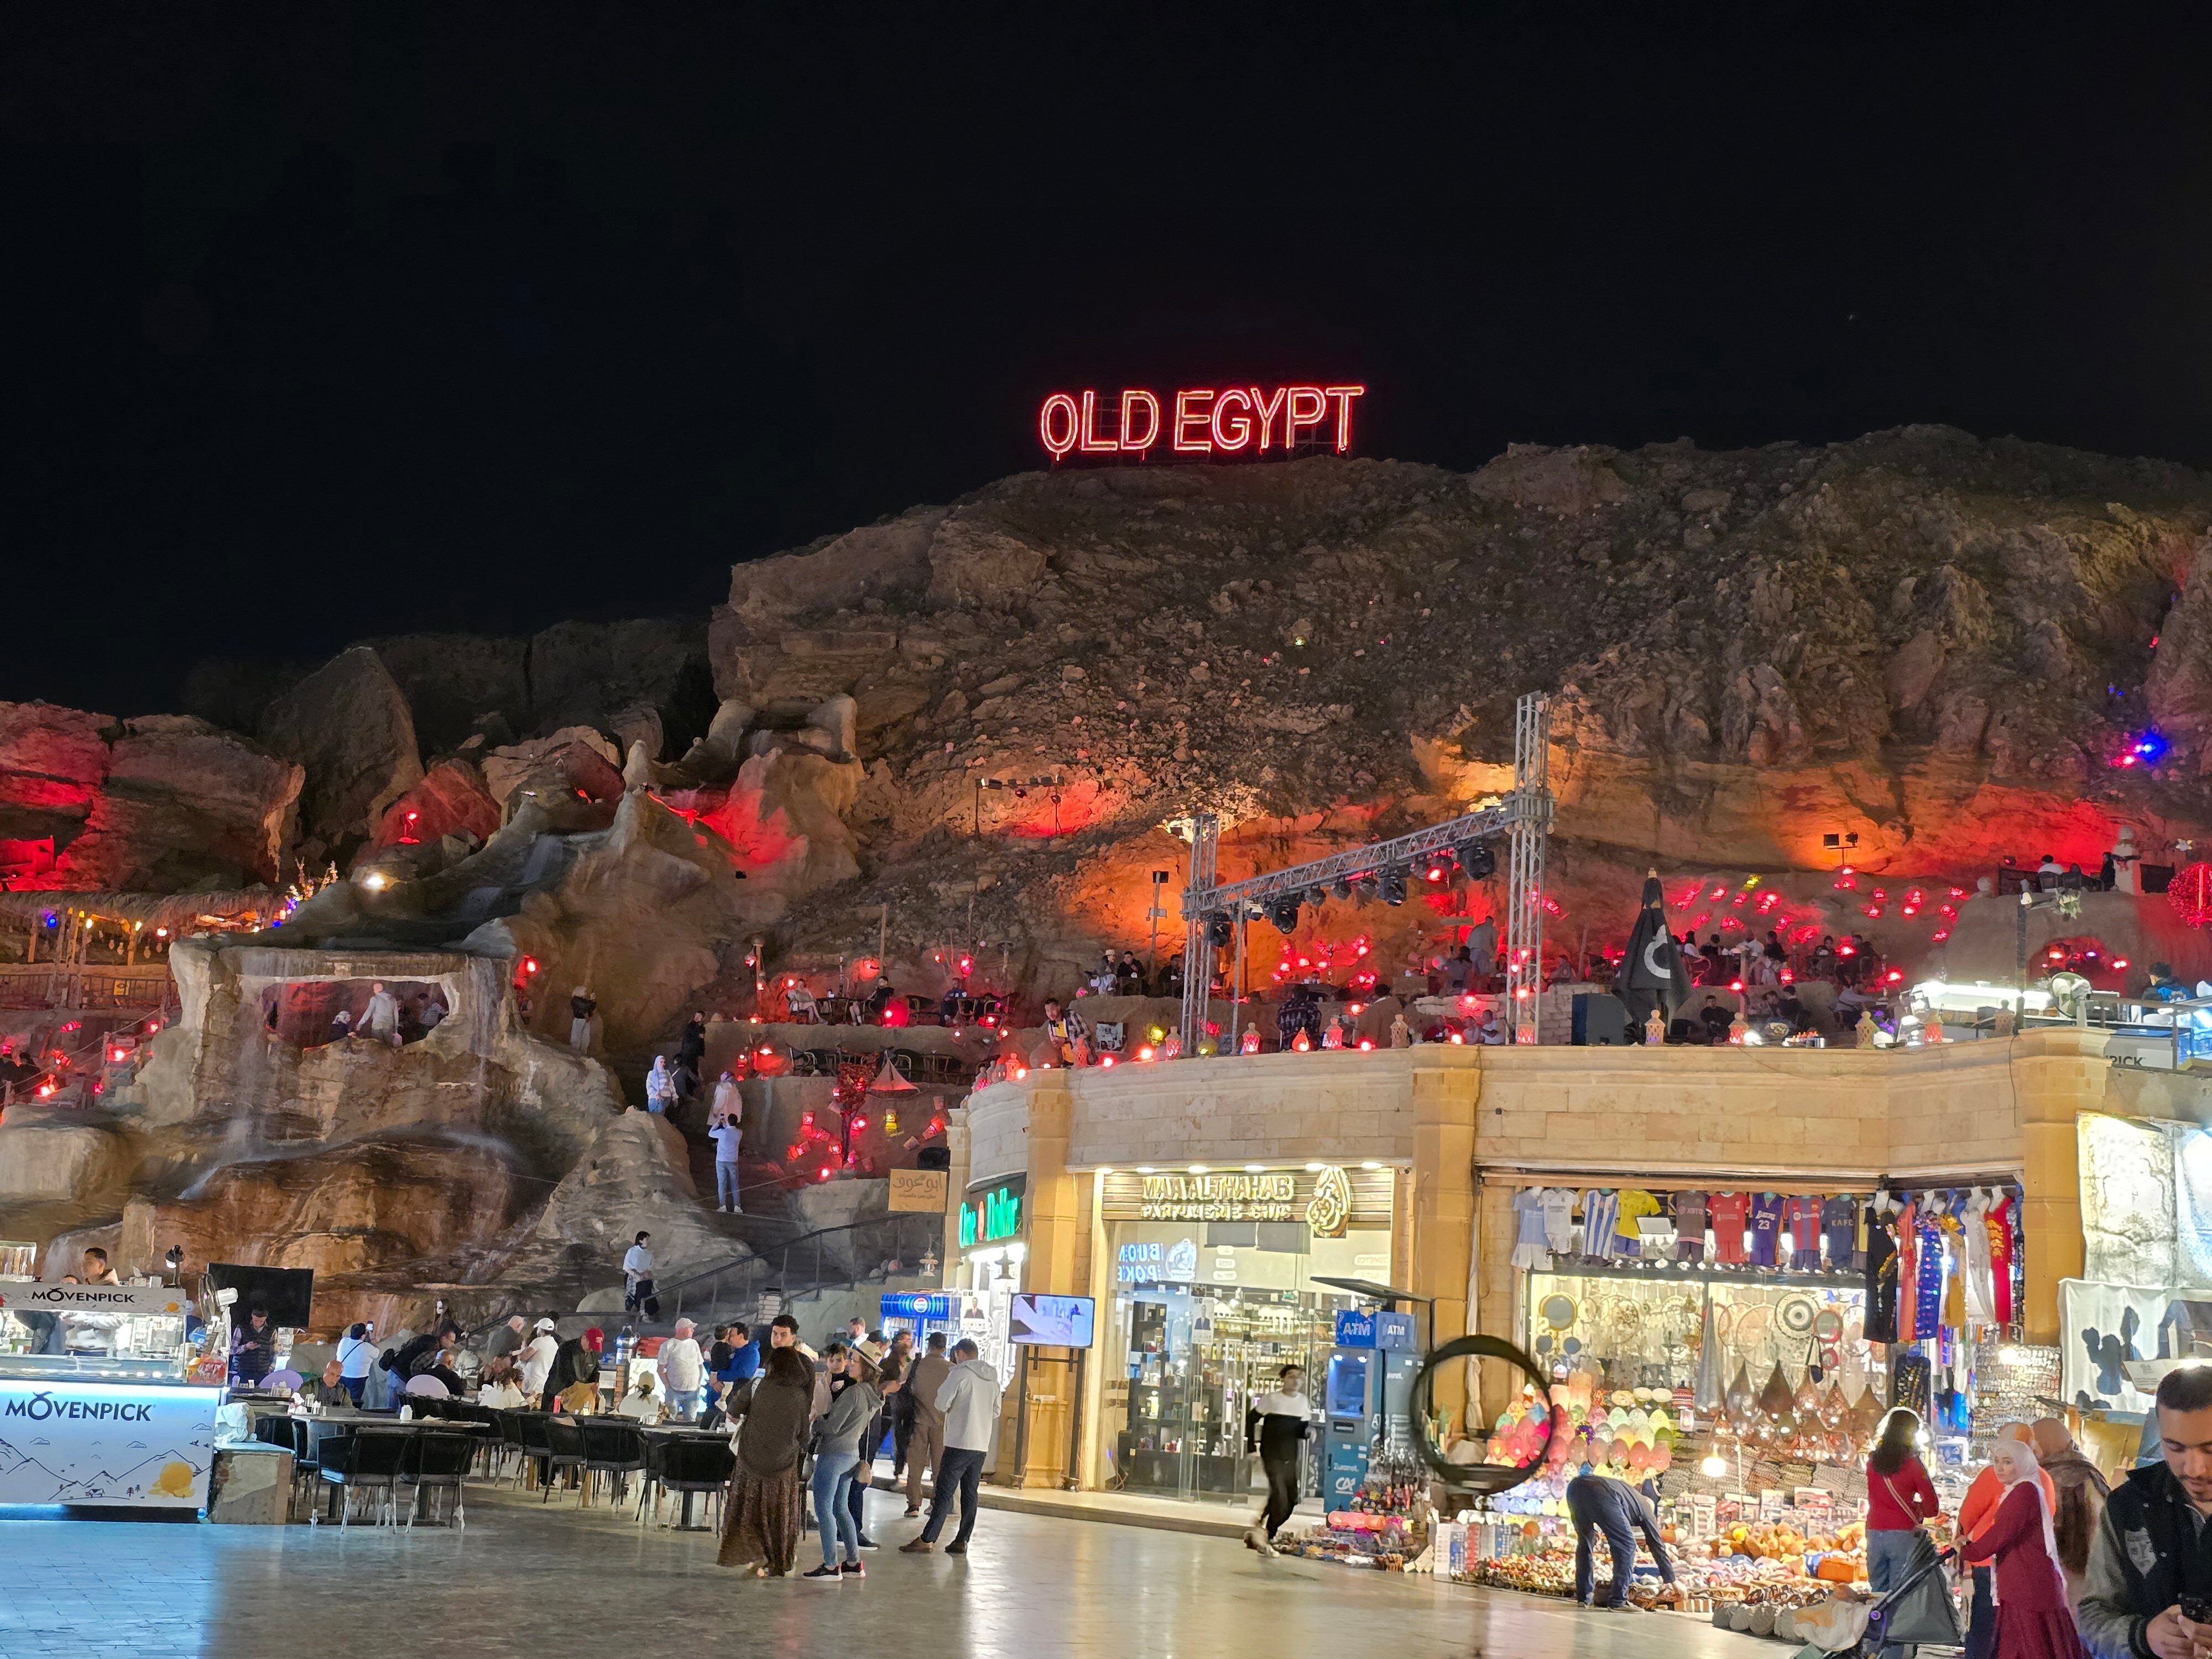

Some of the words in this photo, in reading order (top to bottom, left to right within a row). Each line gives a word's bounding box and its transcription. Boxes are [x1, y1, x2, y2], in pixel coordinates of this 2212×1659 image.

[1040, 390, 1160, 455] OLD
[1174, 386, 1365, 453] EGYPT
[2105, 1055, 2143, 1066] PICK
[893, 1174, 926, 1192] عوف
[986, 1187, 1018, 1242] Dollar
[1757, 1219, 1770, 1229] 23
[1343, 1322, 1371, 1336] ATM
[1387, 1324, 1405, 1336] ATM
